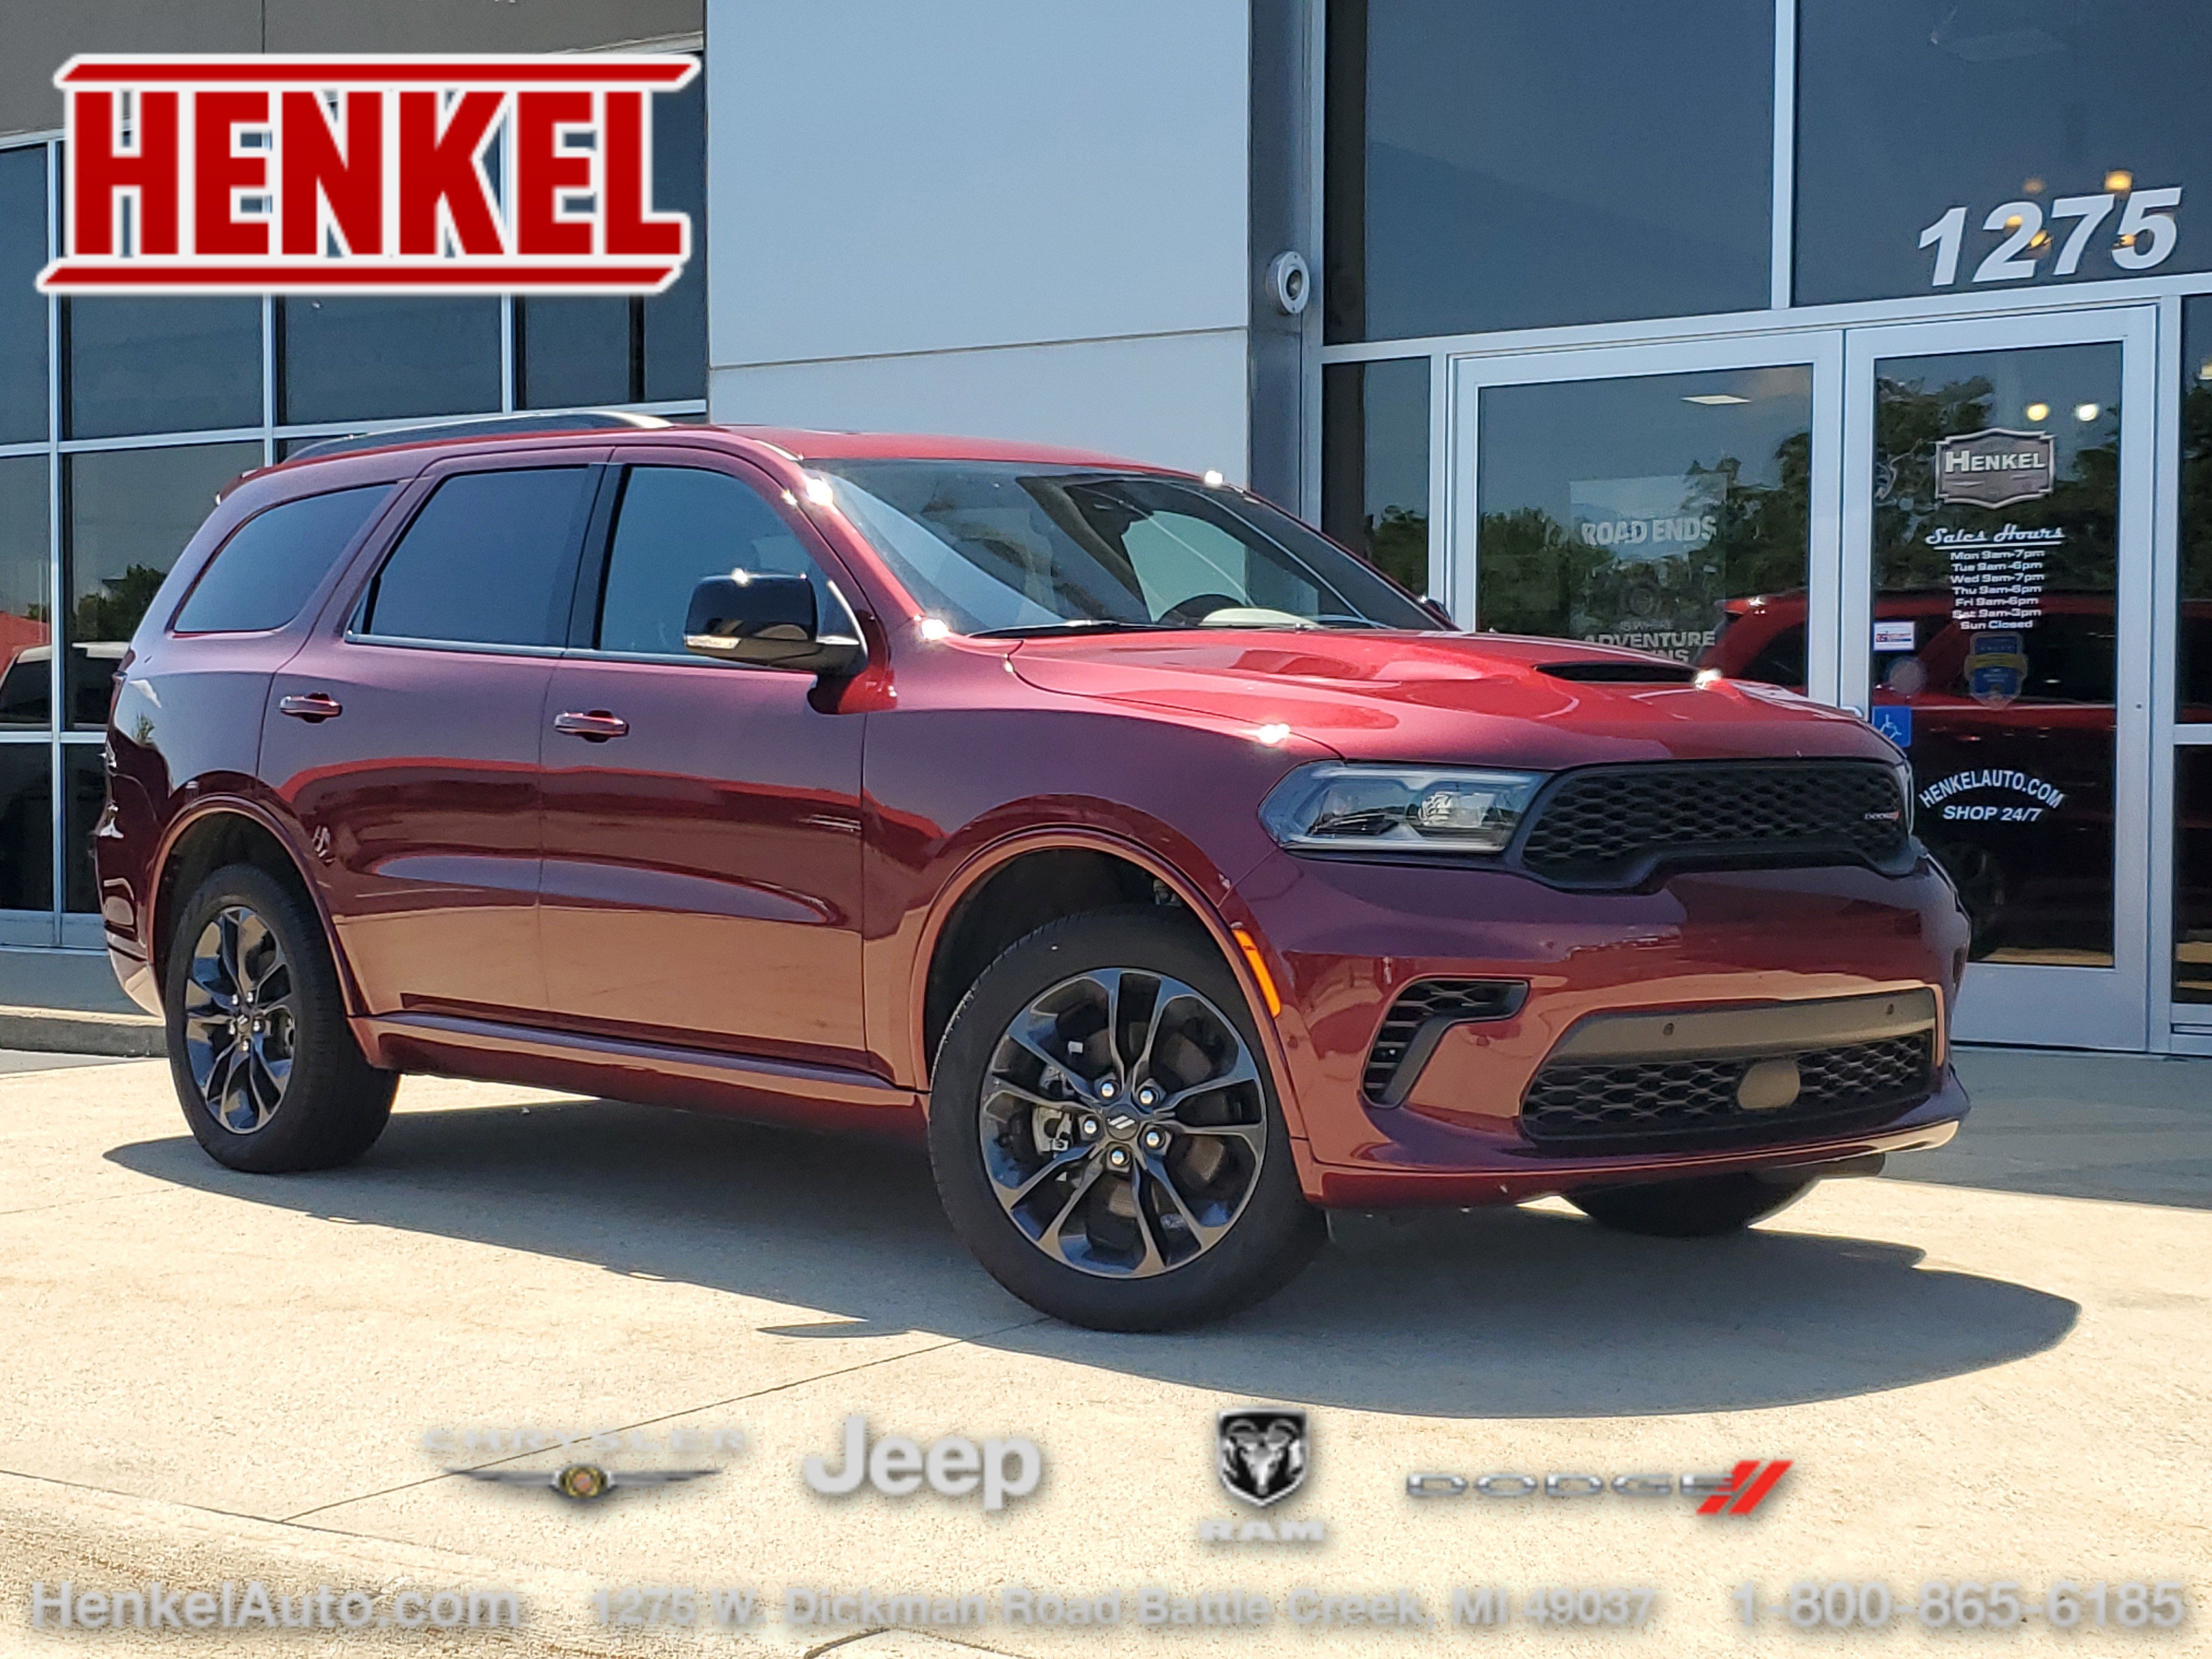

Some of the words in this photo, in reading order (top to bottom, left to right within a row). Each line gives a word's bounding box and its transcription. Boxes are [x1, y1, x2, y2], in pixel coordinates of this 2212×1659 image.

[1917, 187, 2182, 286] 1275
[1945, 450, 2046, 473] HENKEL
[1581, 521, 1647, 545] ROAD
[1652, 516, 1716, 542] ENDS
[1925, 528, 1987, 544] Sales
[1993, 523, 2066, 542] Hours
[1950, 552, 1979, 560] Mon
[1982, 549, 2045, 559] 9am-7pm
[1951, 563, 1975, 572] Tue
[1950, 575, 1979, 583] Wed
[1982, 573, 2045, 583] 9am-7pm
[1952, 586, 1977, 595] Thu
[1955, 598, 1974, 606] Fri
[1952, 610, 1976, 619] Sat
[1988, 620, 2033, 629] Closed
[1919, 770, 2065, 809] HENKELAUTO.COM
[1943, 805, 1997, 820] SHOP
[2000, 808, 2042, 821] 24/7
